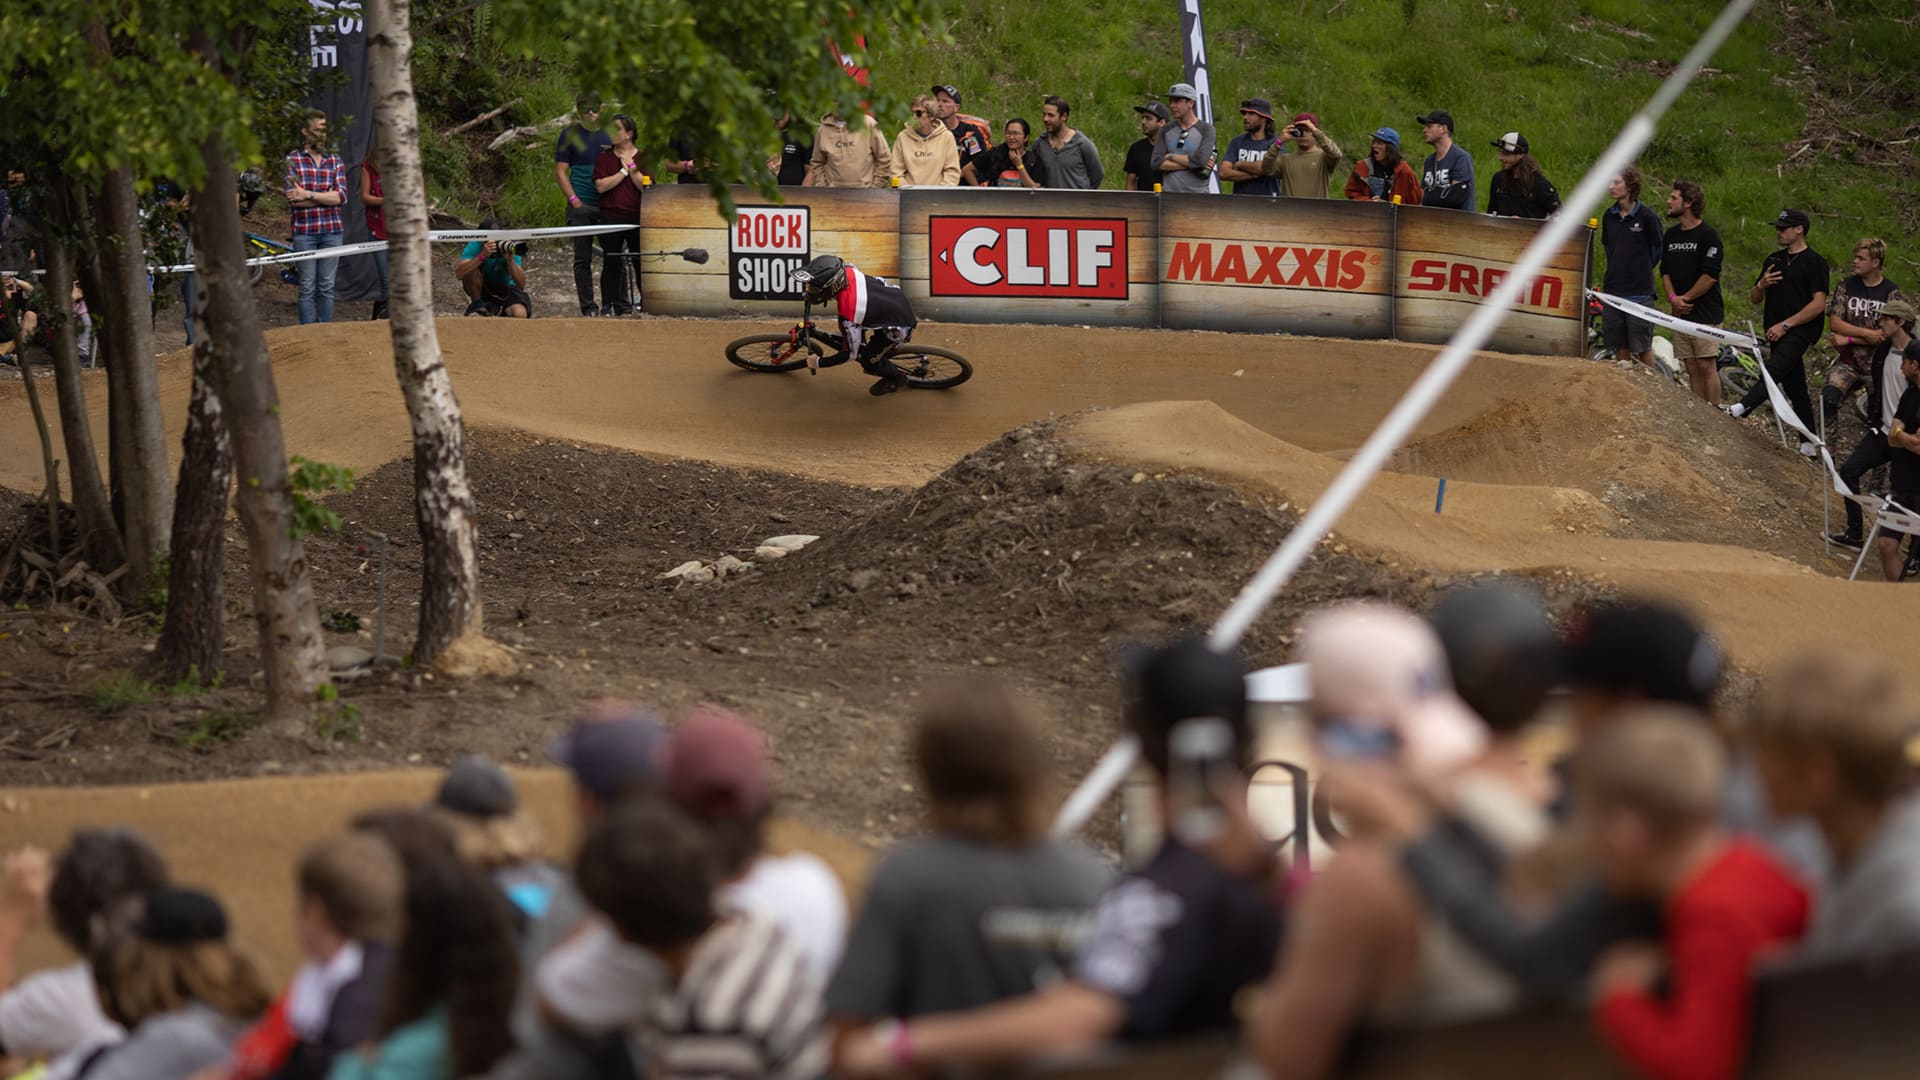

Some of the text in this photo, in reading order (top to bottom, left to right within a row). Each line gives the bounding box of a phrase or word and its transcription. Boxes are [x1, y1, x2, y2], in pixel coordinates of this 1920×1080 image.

[738, 214, 802, 249] ROCK
[738, 257, 803, 293] SHOX
[953, 226, 1114, 287] CLIF
[1166, 241, 1367, 290] MAXXIS
